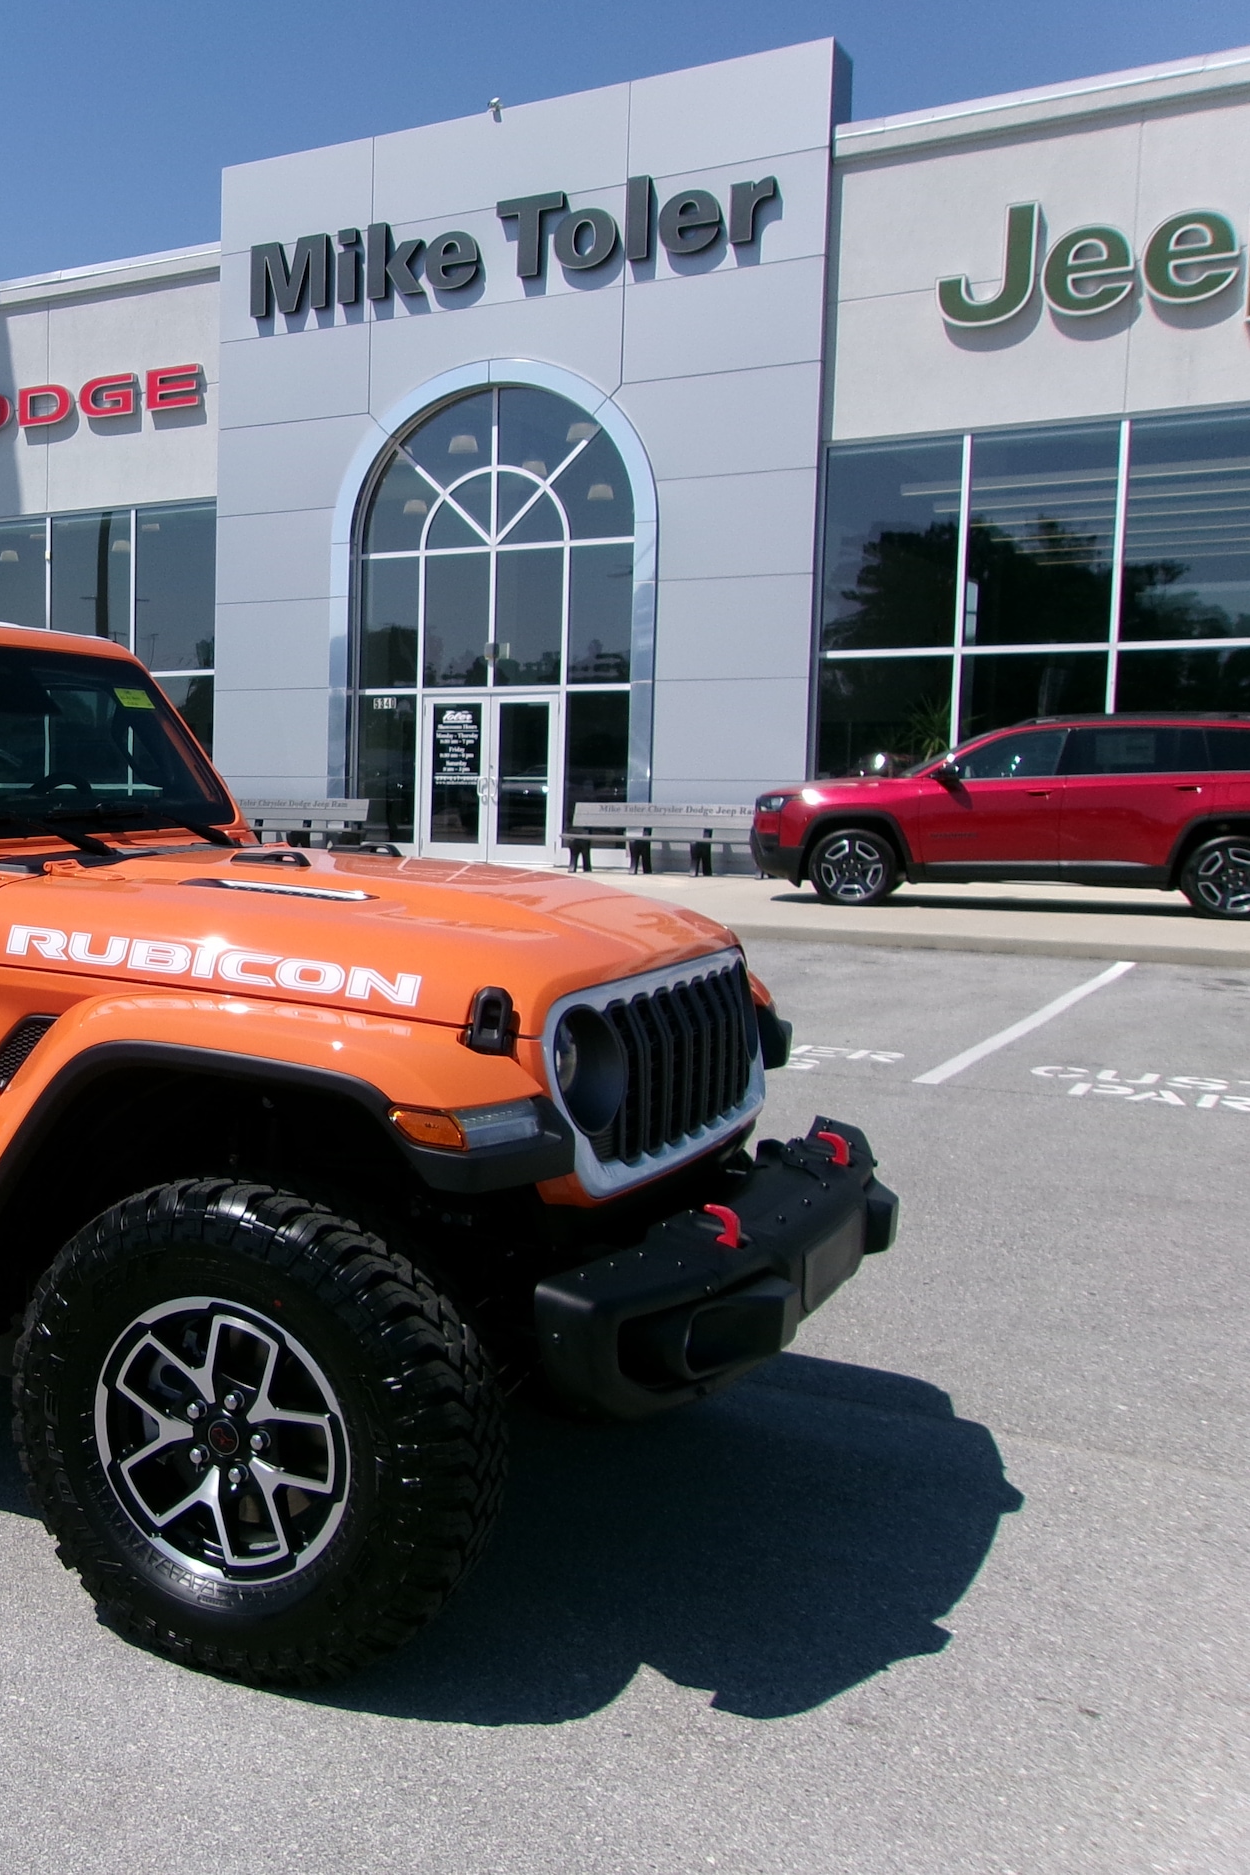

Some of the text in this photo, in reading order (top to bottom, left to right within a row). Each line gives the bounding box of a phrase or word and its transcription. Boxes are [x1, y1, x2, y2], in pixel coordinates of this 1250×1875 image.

[250, 175, 778, 318] Mike Toler
[935, 199, 1250, 327] Jee
[239, 799, 348, 810] Toler Chrysler Dodge Jeep Ram
[598, 804, 755, 817] Mike Toler Chrysler Dodge Jeep Ra
[6, 924, 422, 1007] RUBICON
[1030, 1065, 1250, 1091] CUS
